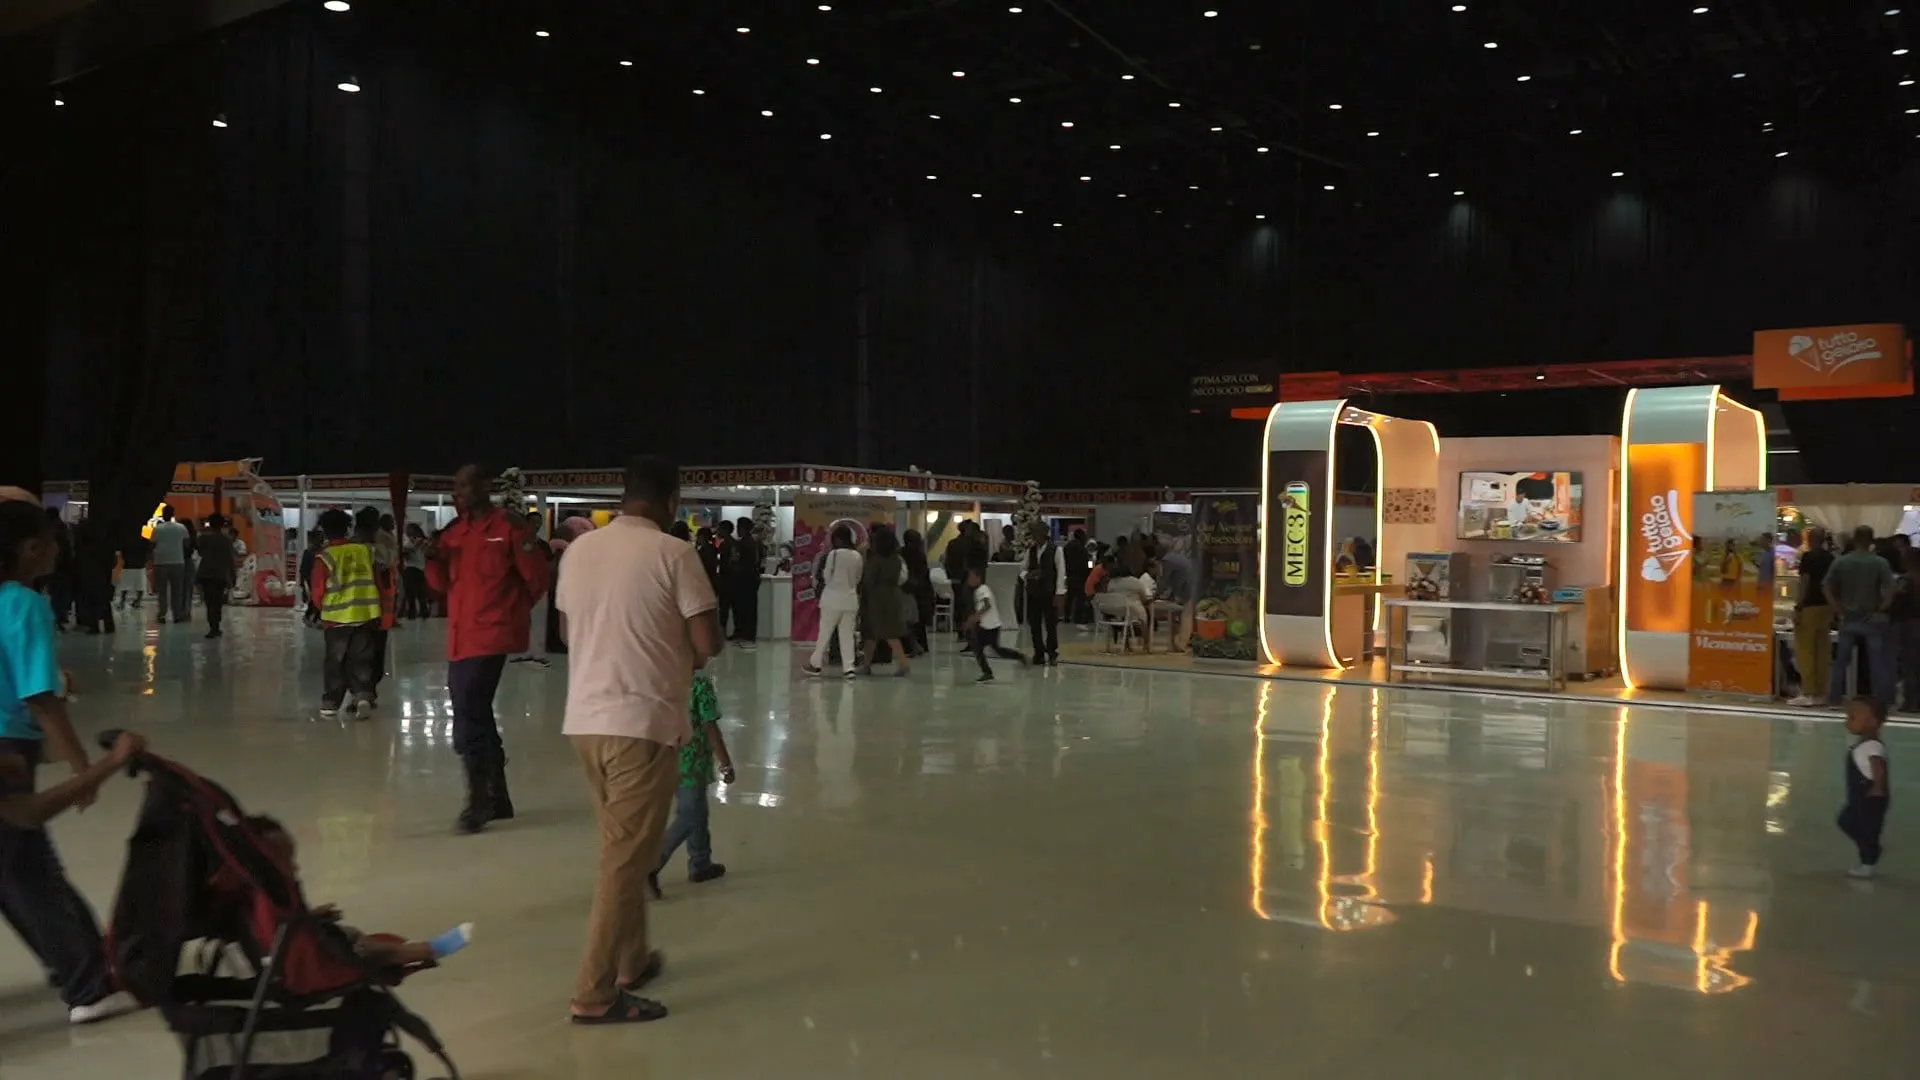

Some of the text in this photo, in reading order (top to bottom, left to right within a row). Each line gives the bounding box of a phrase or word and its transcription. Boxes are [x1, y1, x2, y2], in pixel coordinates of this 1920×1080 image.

[1817, 332, 1857, 350] tutto
[531, 472, 624, 486] BACIO CREMERIA
[680, 470, 776, 484] CIO CREMERIA
[821, 470, 909, 488] BACIO CREMERIA
[941, 481, 1014, 495] BACIO CREMERIA
[1650, 495, 1683, 549] gelato
[1640, 513, 1663, 553] tutto
[1287, 514, 1305, 577] MEC3
[1696, 636, 1768, 653] Memories
